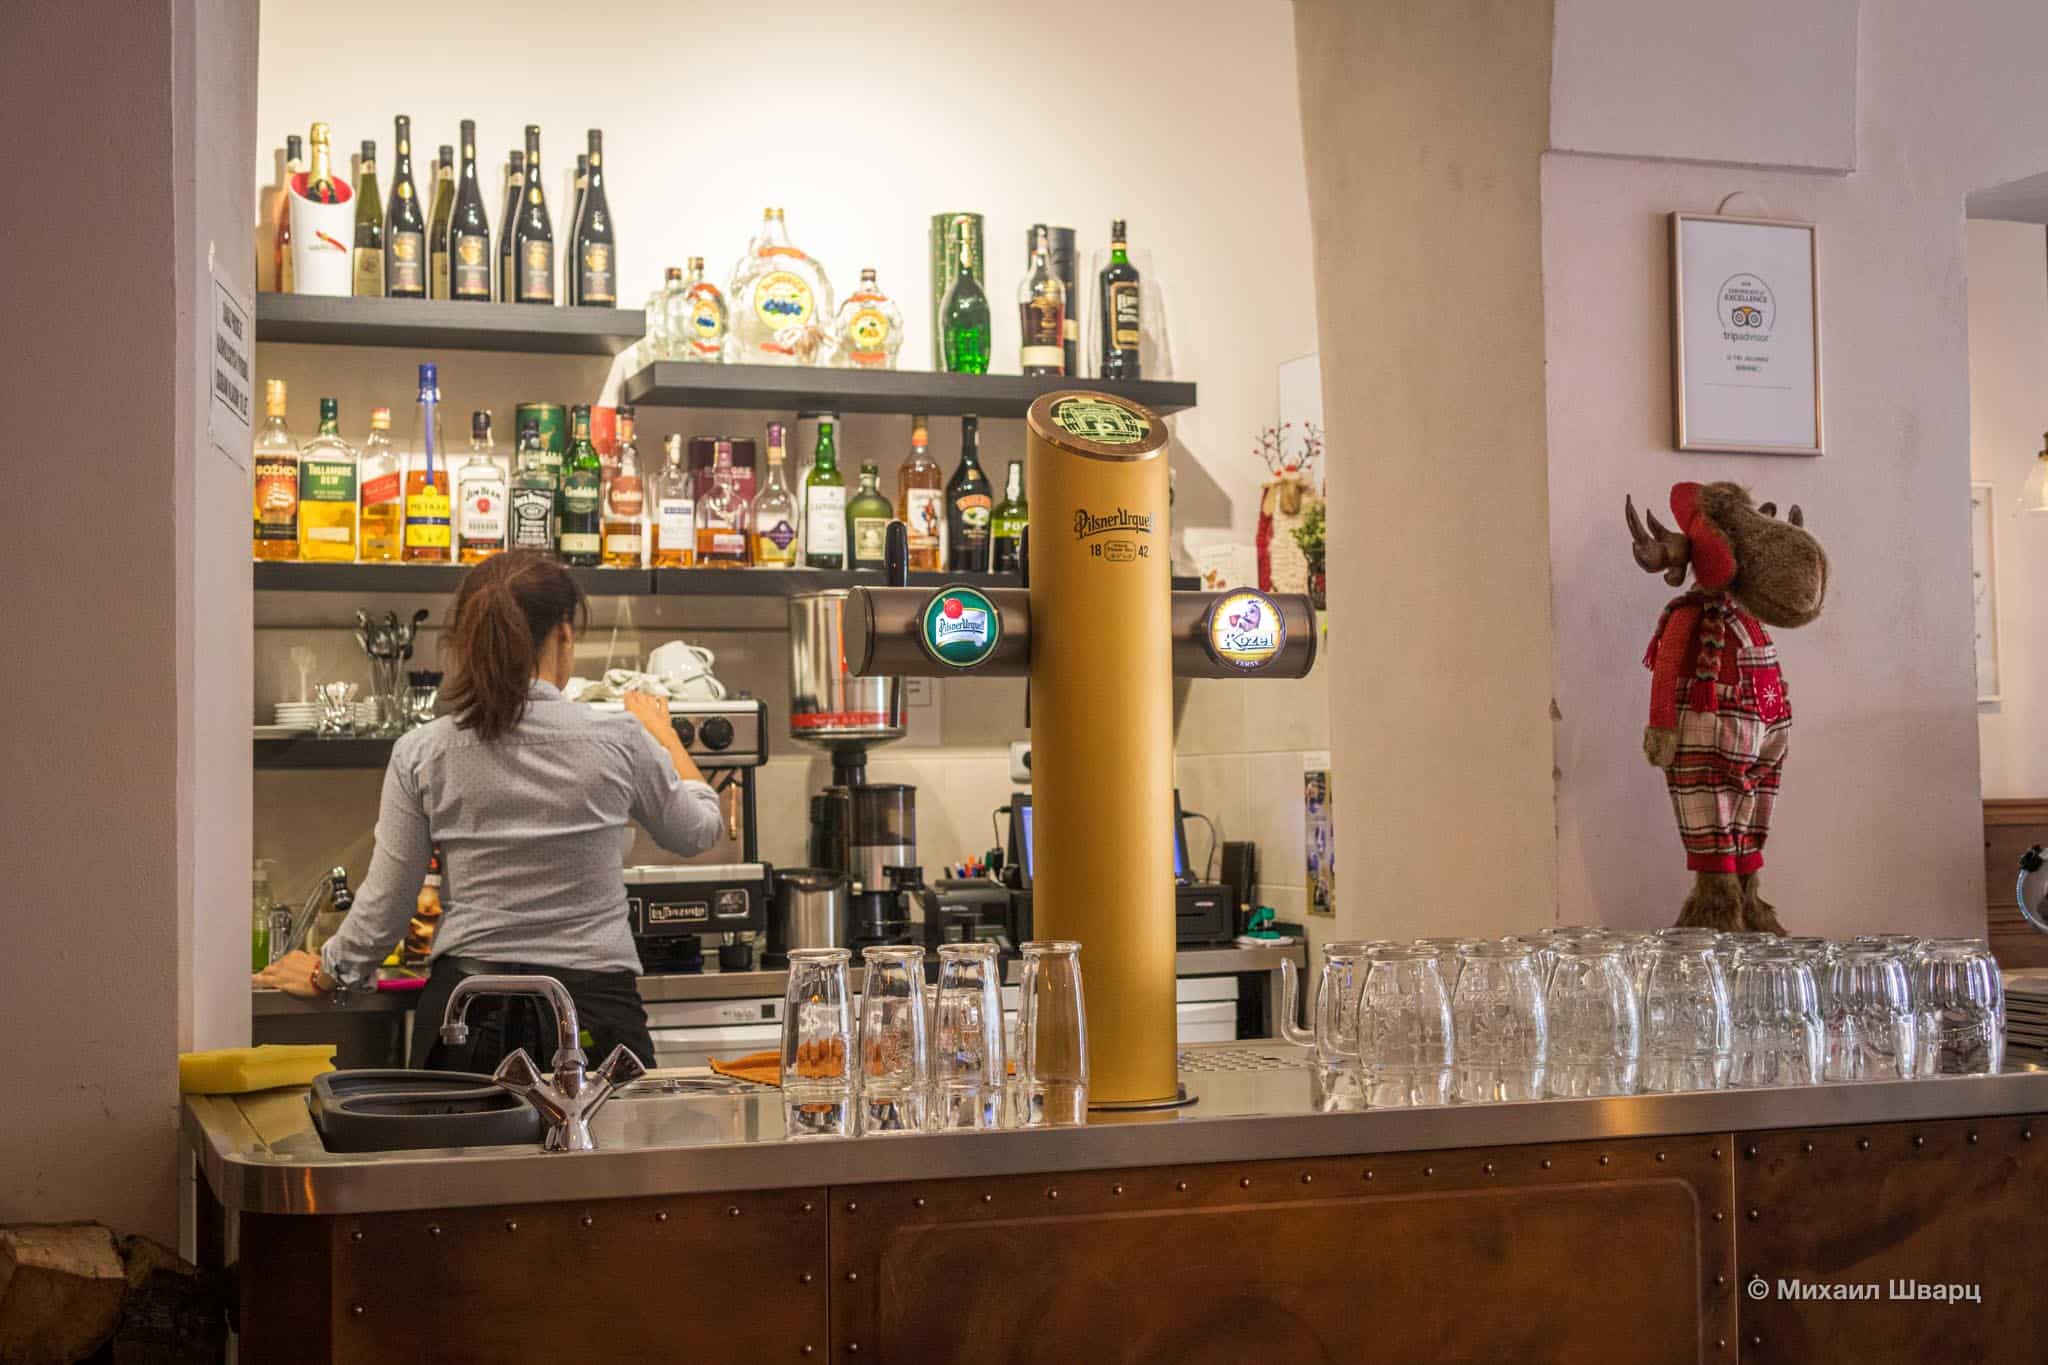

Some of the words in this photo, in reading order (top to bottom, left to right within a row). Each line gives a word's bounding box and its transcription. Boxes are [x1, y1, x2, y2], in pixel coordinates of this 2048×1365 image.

[1074, 508, 1119, 540] Pilsner
[1118, 507, 1153, 534] Urquel
[1090, 544, 1102, 557] 18
[1138, 545, 1149, 558] 42
[938, 618, 962, 637] Pilsner
[1223, 629, 1274, 650] Kozel
